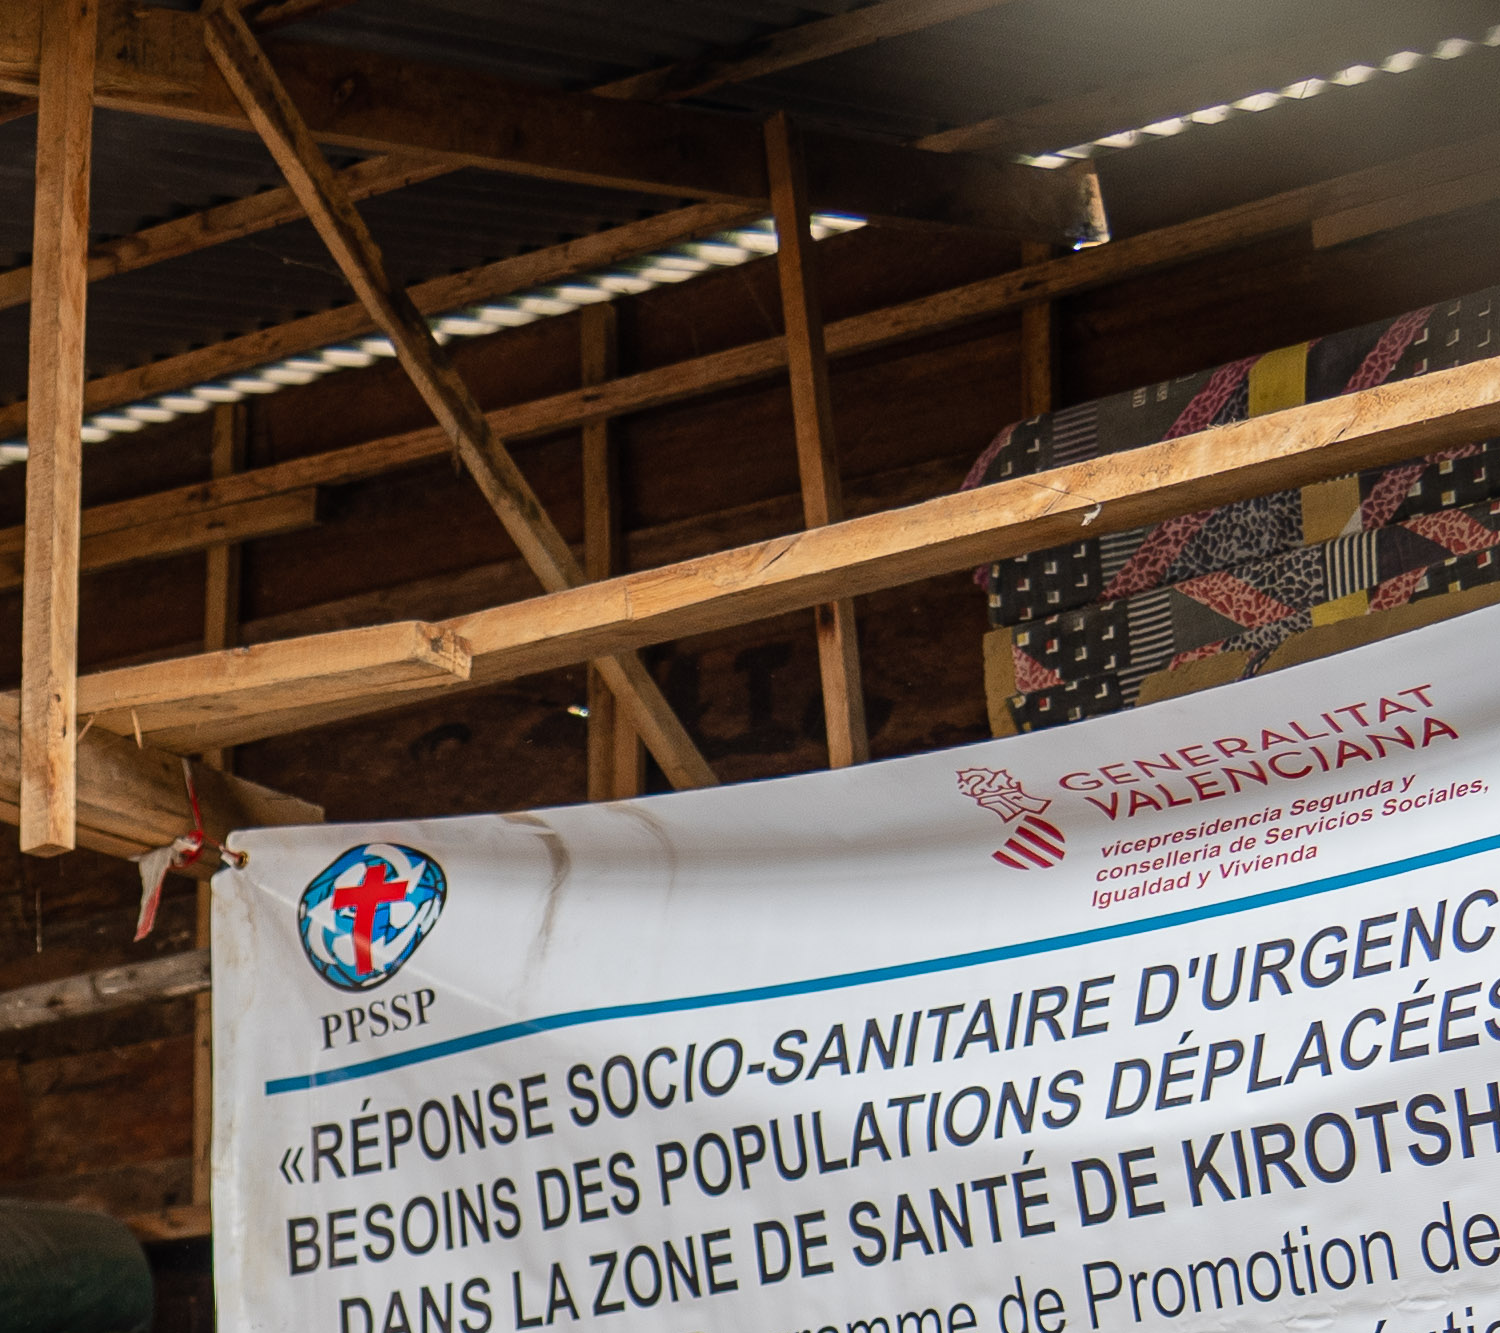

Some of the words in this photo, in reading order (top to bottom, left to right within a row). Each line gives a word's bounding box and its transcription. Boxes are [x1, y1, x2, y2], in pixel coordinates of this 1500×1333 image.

[1058, 684, 1433, 792] GENERALITAT
[1083, 717, 1459, 821] VALENCIANA
[1096, 843, 1221, 883] conselleria
[1228, 832, 1257, 852] de
[1265, 807, 1374, 846] Servicios
[1381, 778, 1488, 816] Sociales,
[1100, 807, 1282, 859] vicepresidencia
[1289, 778, 1395, 818] Segunda
[1400, 773, 1416, 794] y
[1091, 872, 1190, 910] Igualdad
[1197, 868, 1211, 890] y
[1219, 842, 1318, 880] Vivienda
[320, 988, 437, 1051] PPSSP
[279, 1074, 554, 1185] «RÉPONSE
[567, 974, 1115, 1128] SOCIO-SANITAIRE
[286, 1176, 523, 1276] BESOINS
[536, 1152, 641, 1231] DES
[661, 1069, 1084, 1208] POPULATIONS
[513, 1262, 580, 1331] LA
[591, 1228, 739, 1315] ZONE
[755, 1208, 835, 1285] DE
[850, 1151, 1055, 1267] SANTÉ
[1072, 1146, 1165, 1227] DE
[1084, 1224, 1397, 1331] Promotion
[1420, 1201, 1500, 1274] de
